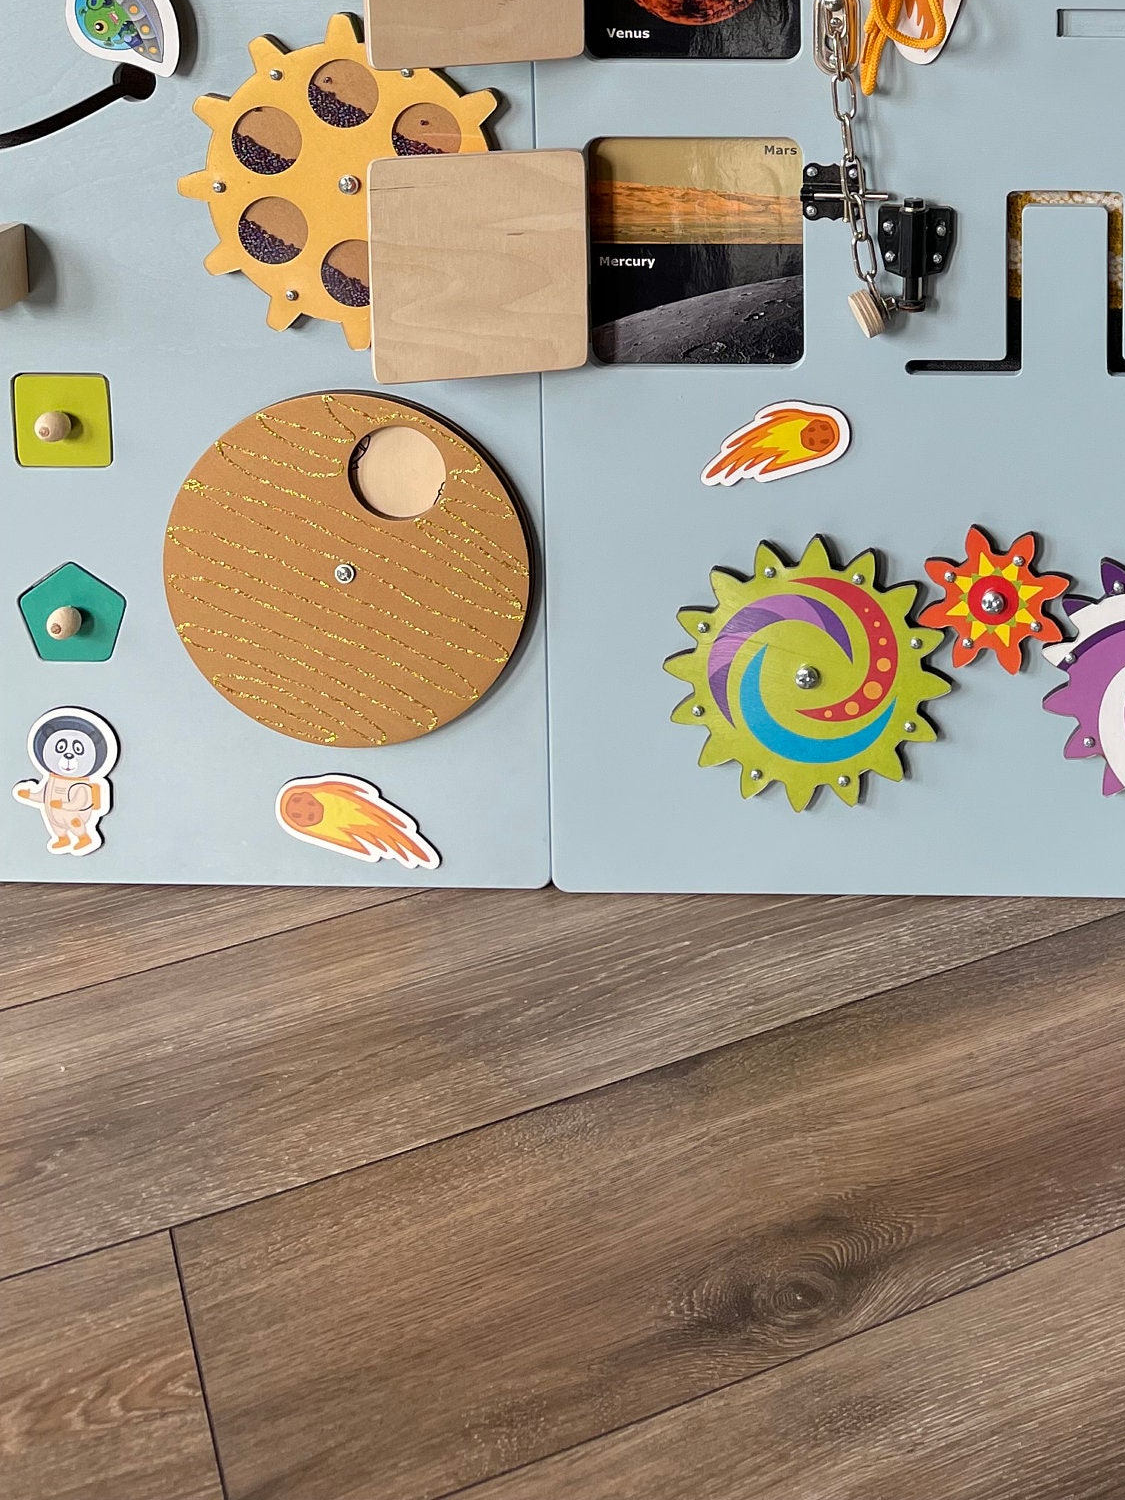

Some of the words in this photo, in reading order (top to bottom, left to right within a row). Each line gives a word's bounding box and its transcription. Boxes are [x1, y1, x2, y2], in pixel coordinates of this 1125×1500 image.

[606, 27, 650, 39] Venus
[764, 145, 798, 156] Mars
[599, 256, 656, 269] Mercury
